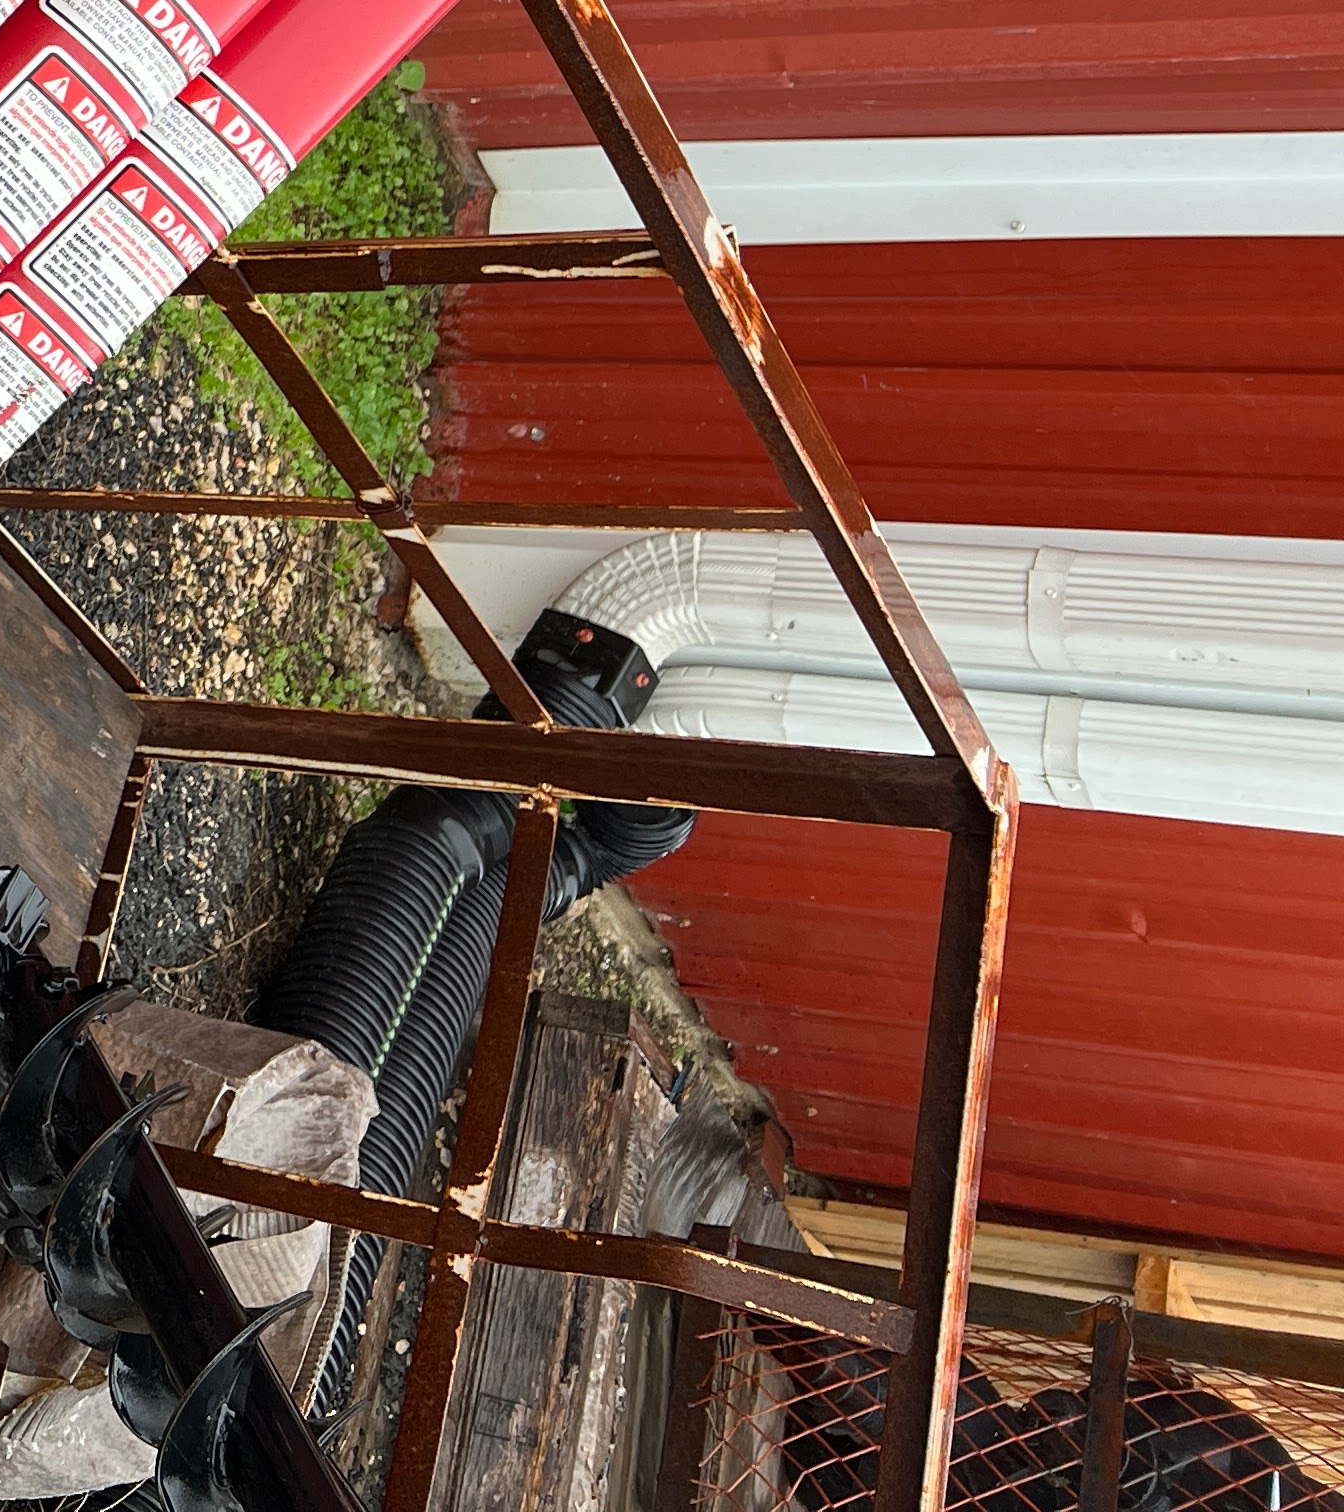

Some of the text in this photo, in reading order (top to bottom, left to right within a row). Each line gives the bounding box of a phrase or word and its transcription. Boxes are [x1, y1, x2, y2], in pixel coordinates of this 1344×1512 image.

[105, 8, 144, 48] HAVE READ
[133, 23, 151, 41] THIS
[35, 98, 70, 133] PREVENT
[70, 96, 128, 159] DANG
[183, 113, 211, 141] ATTACH
[201, 143, 221, 163] READ
[219, 113, 288, 194] DANG
[114, 207, 150, 241] PREVENT
